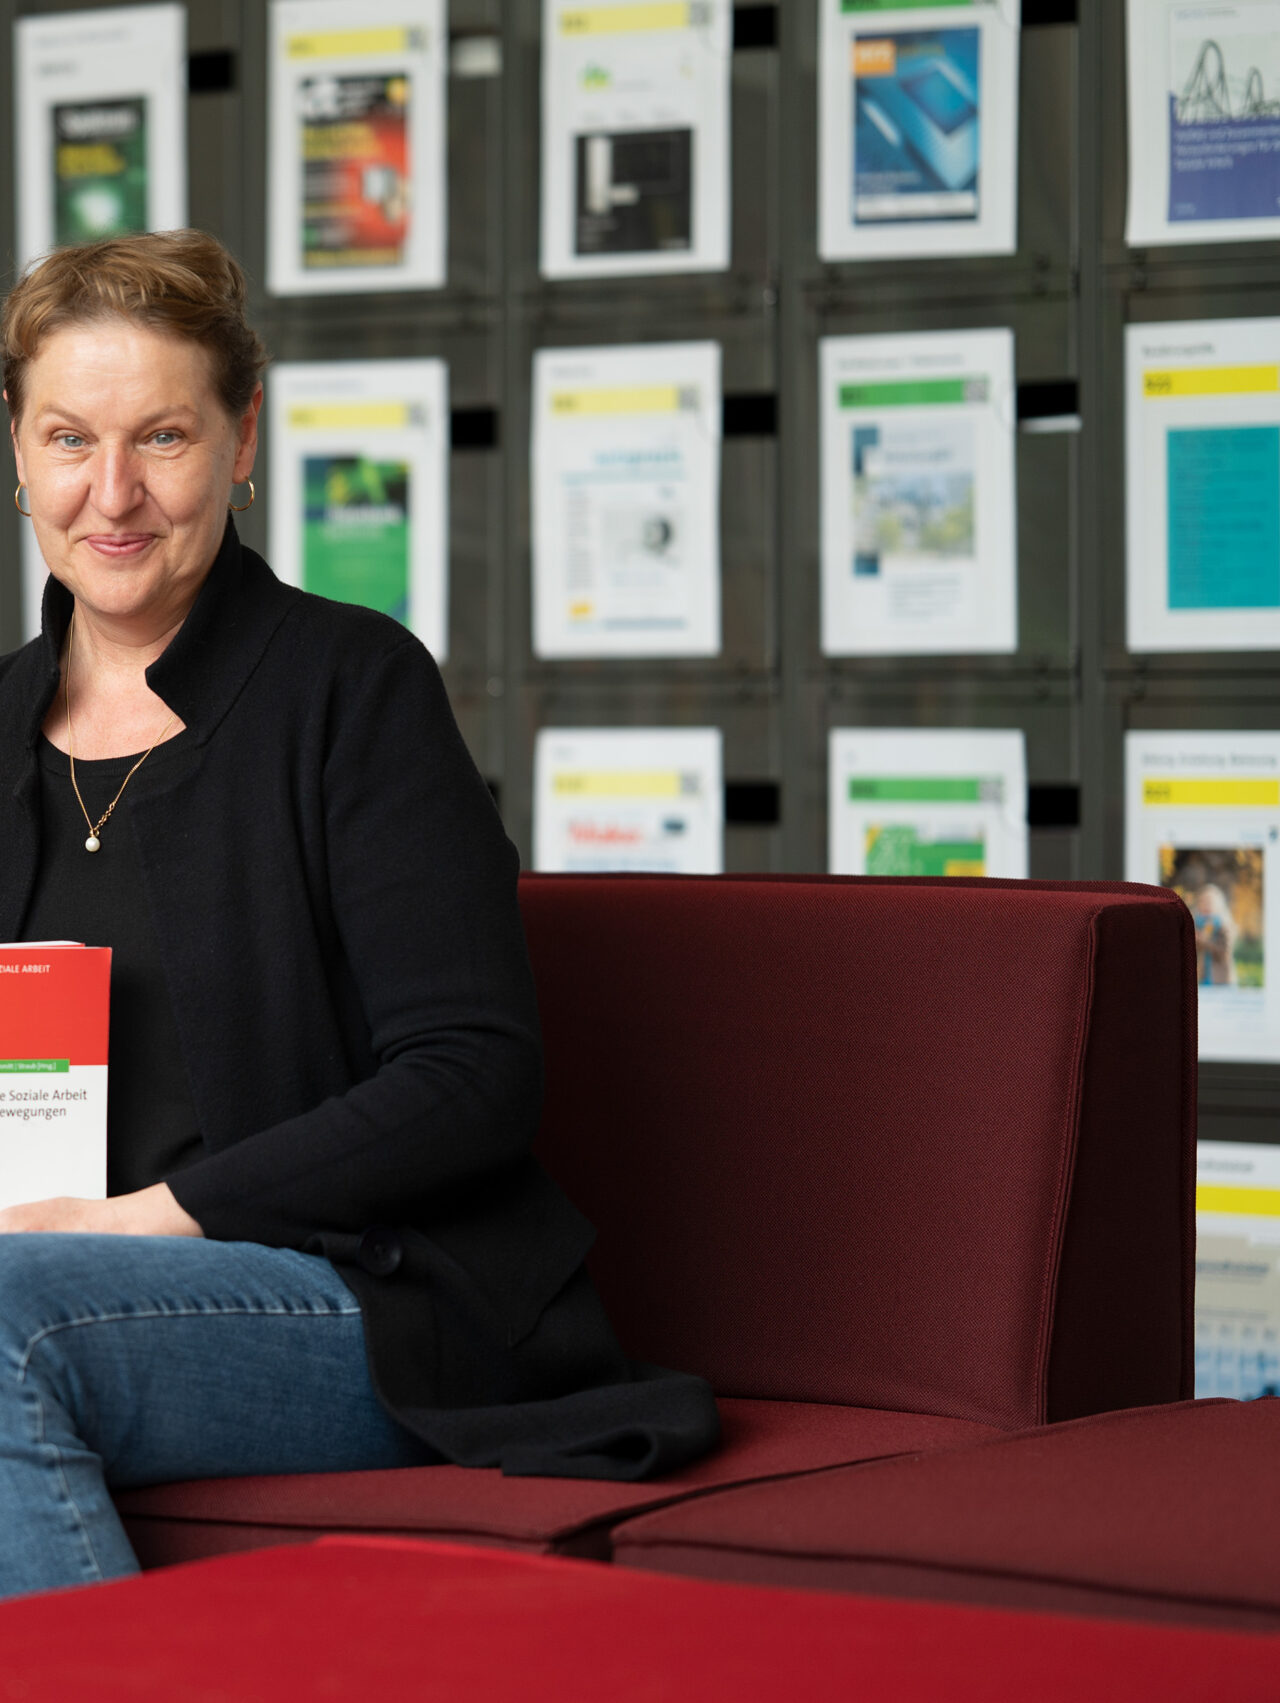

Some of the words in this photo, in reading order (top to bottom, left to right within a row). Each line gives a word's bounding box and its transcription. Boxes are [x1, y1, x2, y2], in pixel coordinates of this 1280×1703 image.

[21, 964, 51, 973] ARBEIT
[9, 1090, 49, 1101] Soziale
[52, 1089, 88, 1100] Arbeit
